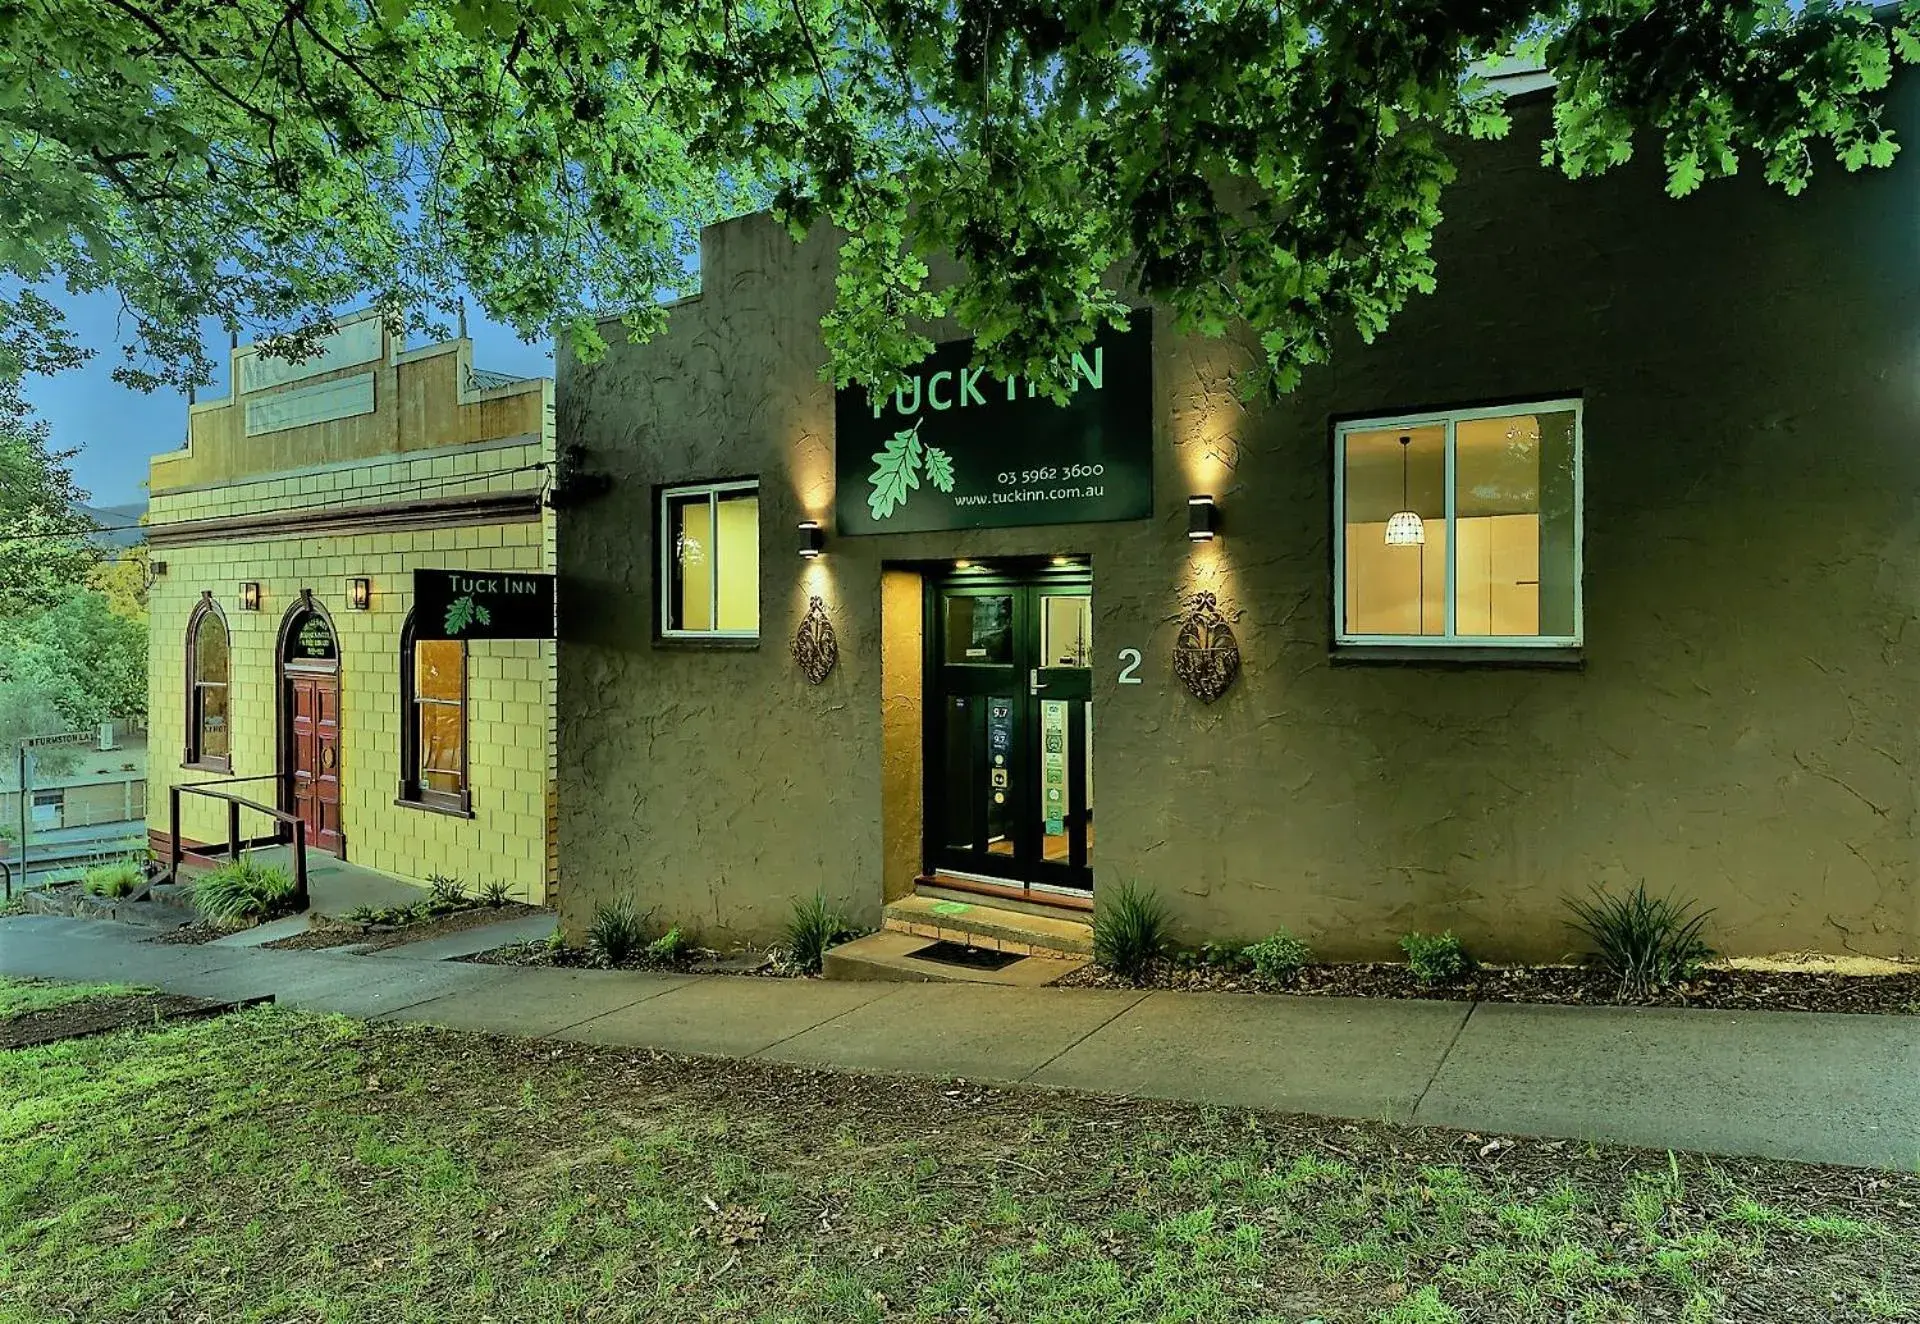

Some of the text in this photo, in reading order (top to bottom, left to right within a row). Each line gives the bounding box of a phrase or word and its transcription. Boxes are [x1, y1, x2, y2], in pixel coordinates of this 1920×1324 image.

[867, 346, 1103, 419] UCK IN
[997, 464, 1104, 485] 03 5962 3600
[954, 486, 1104, 506] www.tuckinn.com.au
[448, 575, 537, 594] TUCK INN
[1118, 648, 1142, 684] 2
